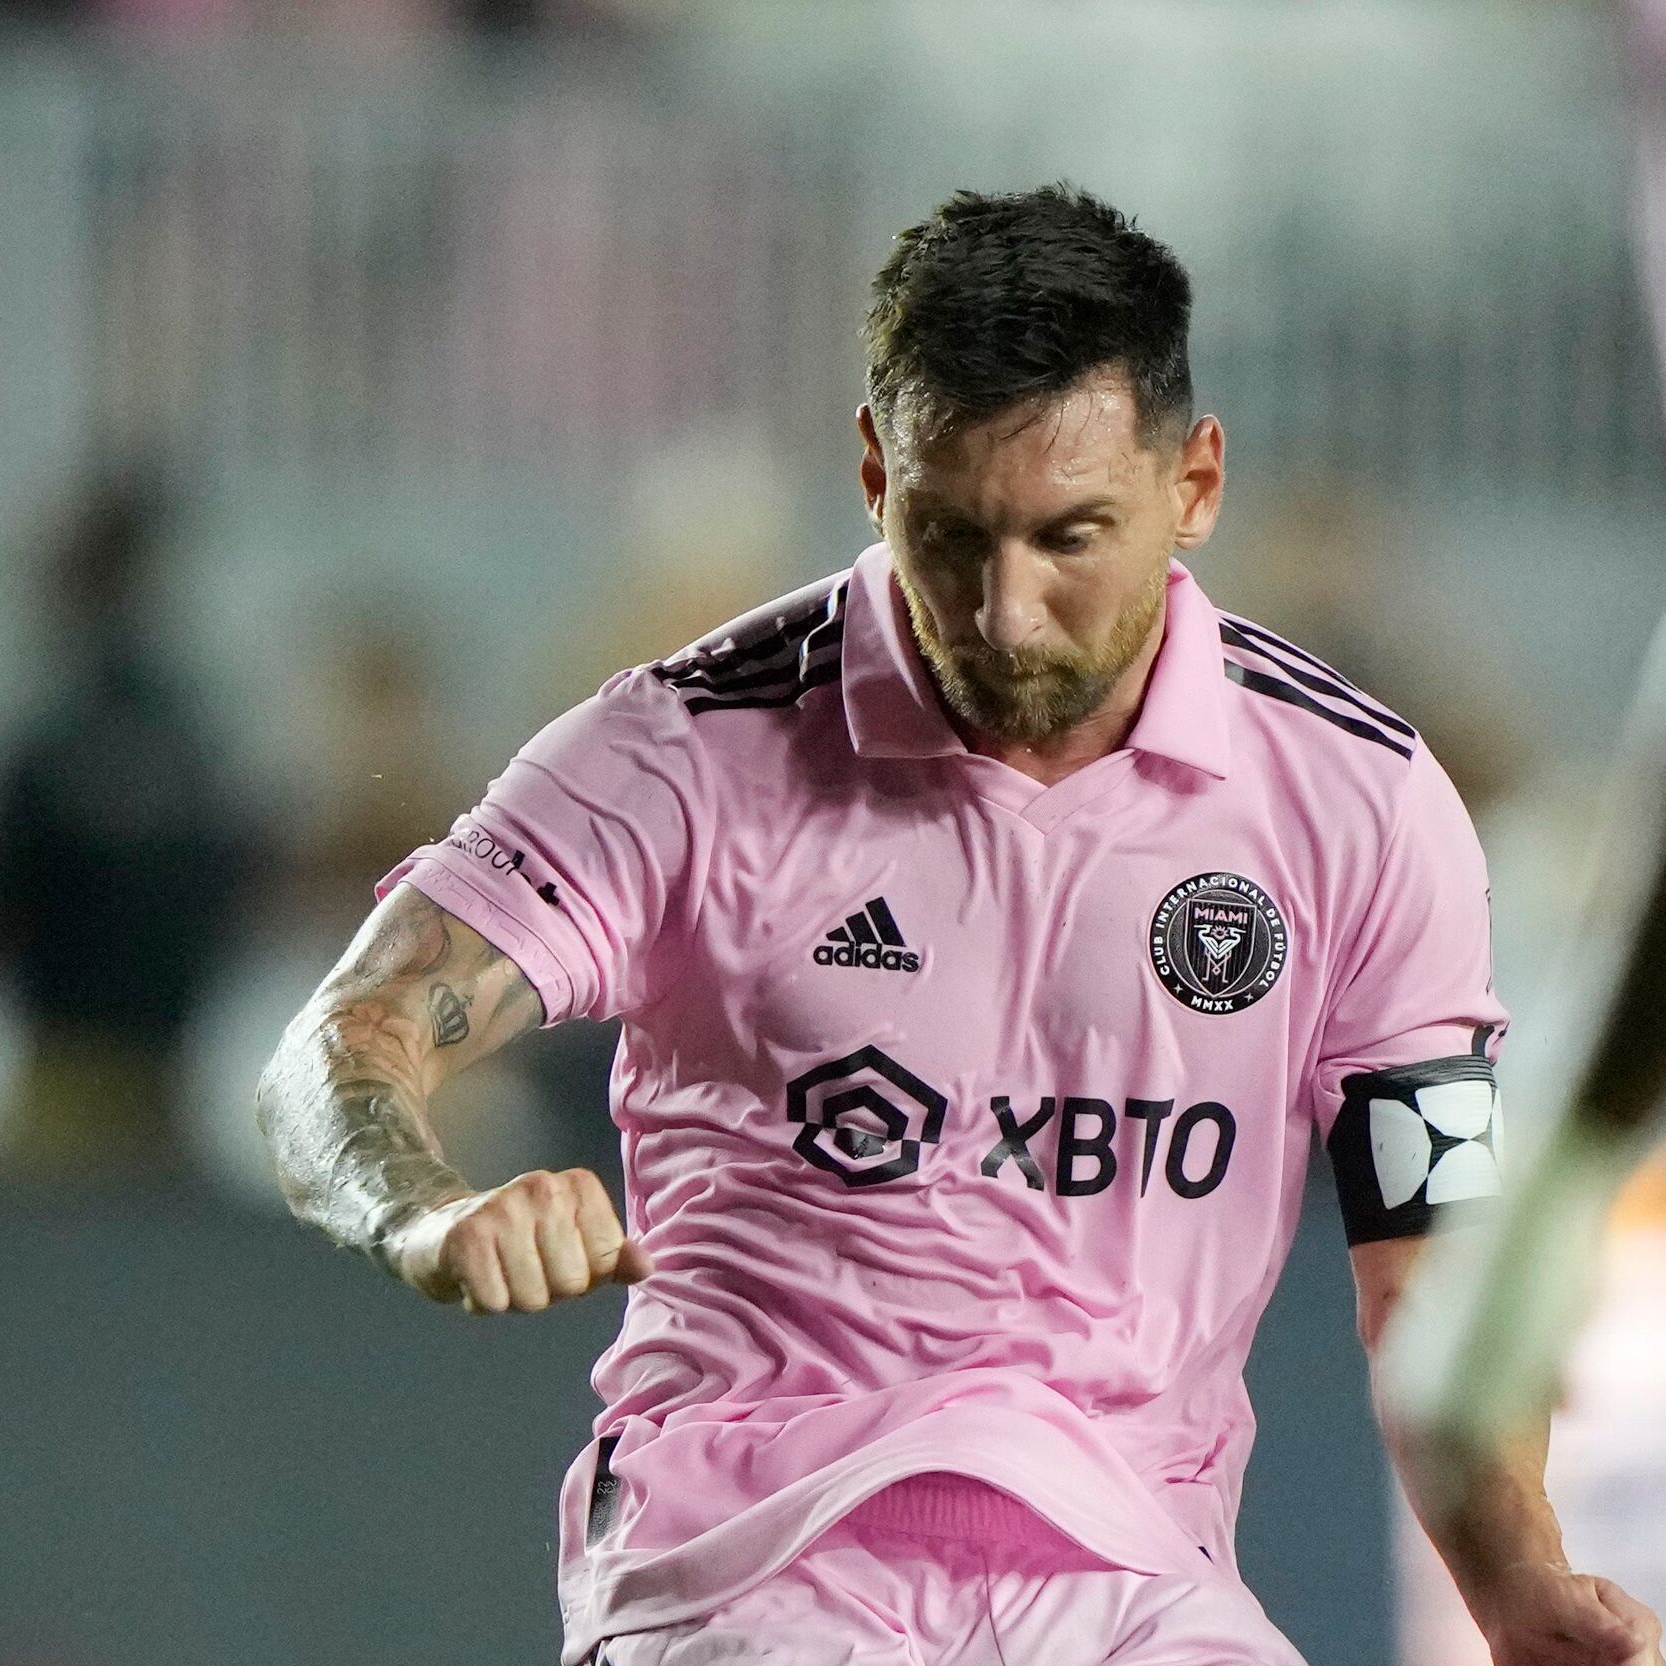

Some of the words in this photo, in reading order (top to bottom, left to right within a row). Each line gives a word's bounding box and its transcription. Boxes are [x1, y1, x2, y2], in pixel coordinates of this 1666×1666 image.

[1155, 876, 1266, 929] INTERNACIONAL
[1194, 907, 1248, 924] MIAMI
[1266, 908, 1281, 927] DE
[813, 941, 919, 973] adidas
[1154, 936, 1170, 976] CLUB
[1191, 995, 1234, 1011] MMXX
[980, 1095, 1237, 1199] XBTO
